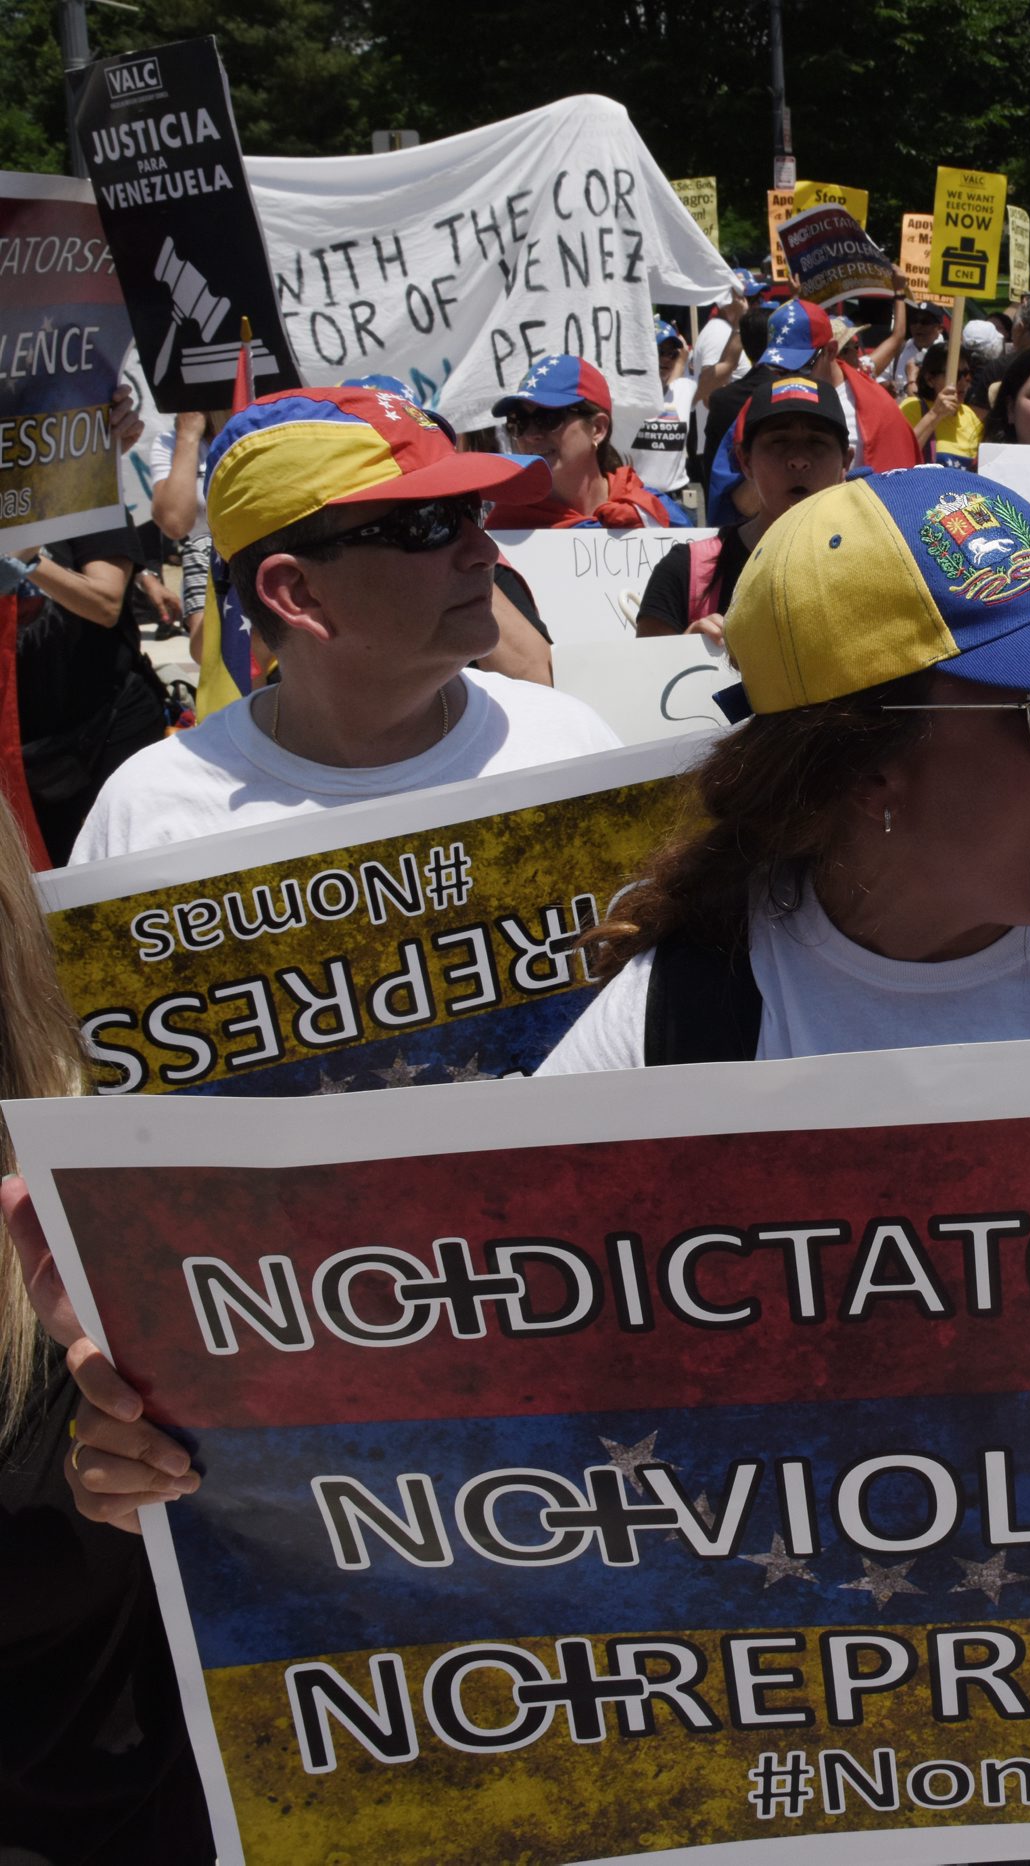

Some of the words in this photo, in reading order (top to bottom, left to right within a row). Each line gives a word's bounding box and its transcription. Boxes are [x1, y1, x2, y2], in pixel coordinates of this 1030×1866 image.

[108, 63, 158, 93] VALC
[92, 107, 221, 164] JUSTICIA
[137, 156, 168, 173] PARA
[101, 164, 233, 210] VENEZUELA
[963, 174, 984, 185] VALC
[680, 193, 714, 208] agro:
[773, 195, 794, 206] Apo
[815, 189, 847, 205] Stop
[946, 190, 962, 200] WE
[966, 192, 995, 203] WANT
[946, 201, 994, 214] ELECTIONS
[434, 190, 533, 266] THE
[553, 168, 637, 220] COR
[945, 212, 992, 231] NOW
[905, 263, 930, 275] Revo
[954, 269, 975, 280] CNE
[405, 275, 459, 335] OF
[129, 842, 473, 962] #Nomas
